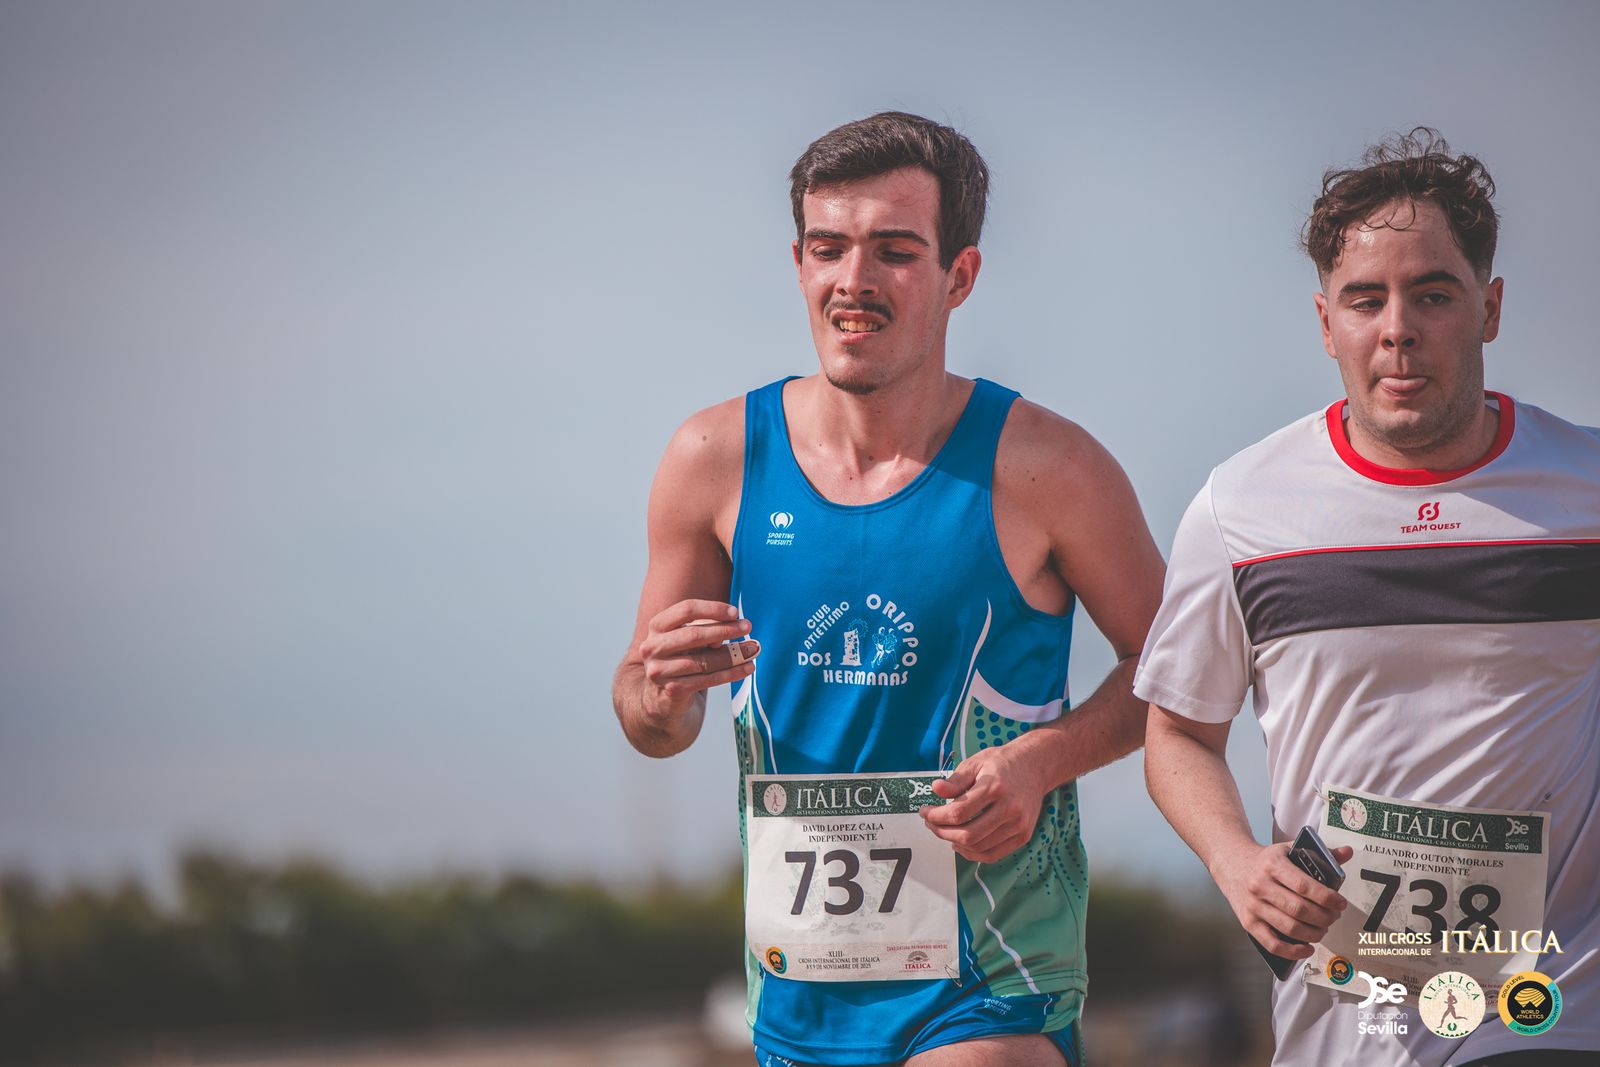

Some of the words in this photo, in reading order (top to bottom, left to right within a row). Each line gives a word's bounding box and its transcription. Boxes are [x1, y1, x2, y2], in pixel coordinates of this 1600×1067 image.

[1401, 524, 1427, 534] TEAM
[1430, 522, 1461, 530] QUEST
[804, 602, 850, 650] ATLETISMO
[806, 604, 831, 629] CLUB
[866, 594, 919, 667] ORIPPO
[798, 652, 831, 666] DOS
[823, 670, 908, 686] HERMANAS
[797, 783, 892, 809] ITÁLICA
[808, 833, 878, 842] INDEPENDIENTE
[827, 824, 857, 832] LOPEZ
[858, 822, 884, 830] CALA
[1382, 810, 1488, 843] ITÁLICA
[1382, 832, 1433, 844] INTERNATIONAL
[1458, 842, 1488, 850] COUNTRY
[1363, 844, 1418, 860] ALEJANDRO
[1420, 854, 1455, 864] OUTON
[1456, 858, 1504, 868] MORALES
[1394, 860, 1470, 876] INDEPENDIENTE
[784, 848, 912, 916] 737
[1360, 868, 1502, 951] 738
